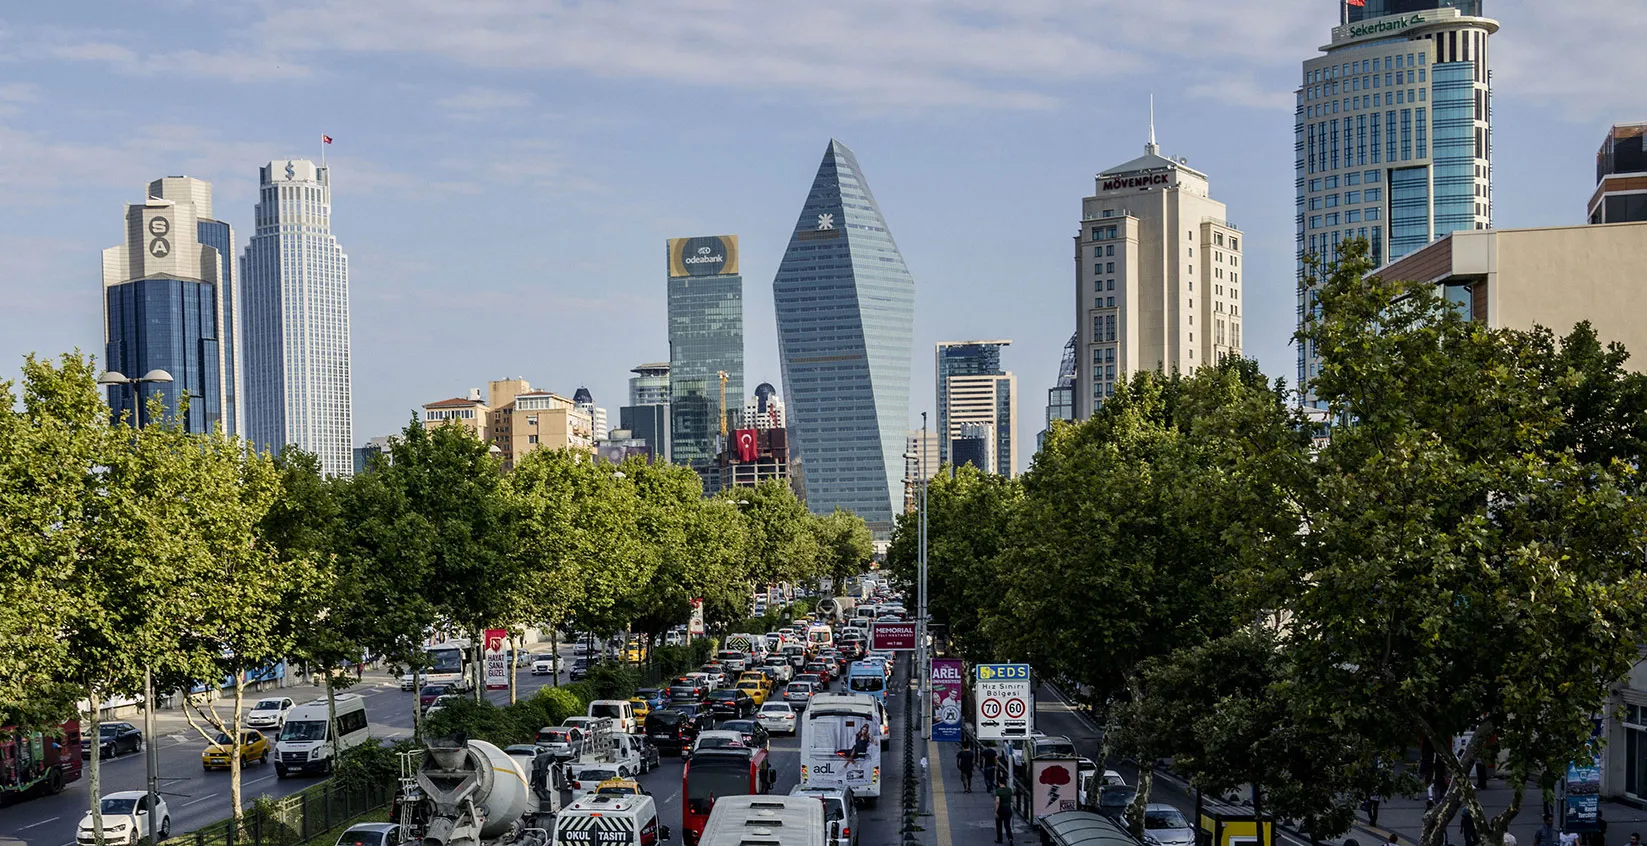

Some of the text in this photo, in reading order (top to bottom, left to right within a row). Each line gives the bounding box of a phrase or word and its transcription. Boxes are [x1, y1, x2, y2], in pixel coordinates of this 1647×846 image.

[685, 254, 724, 264] odeabank
[932, 668, 961, 679] AREL
[997, 667, 1026, 678] EDS
[985, 704, 999, 714] 70
[1008, 703, 1022, 713] 60
[813, 762, 835, 774] adL
[566, 831, 591, 841] OKUL
